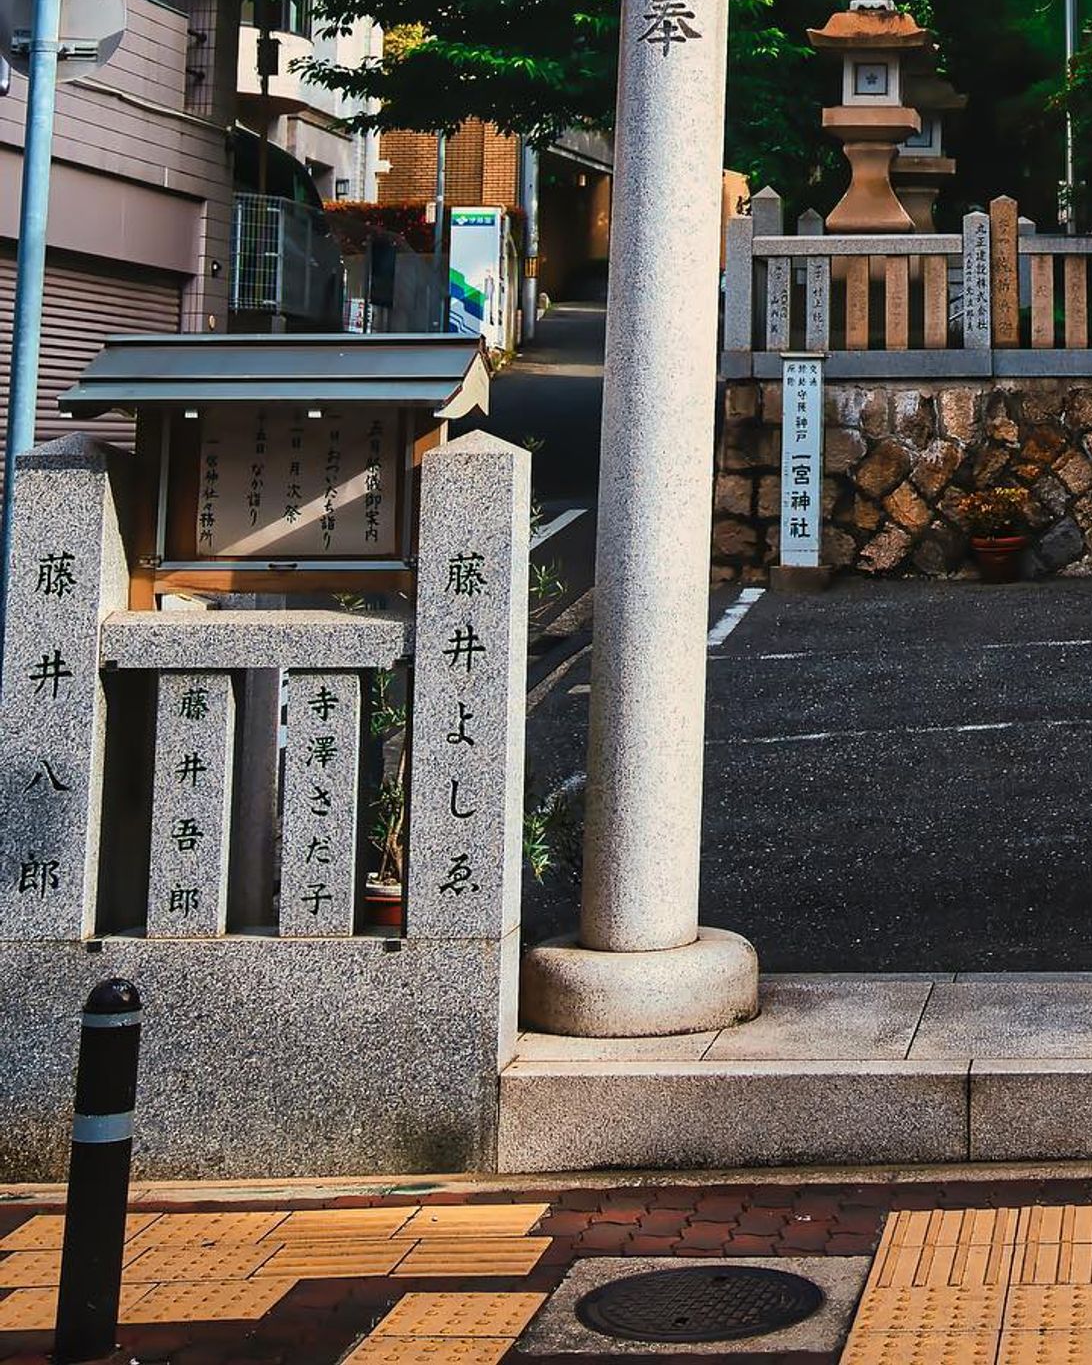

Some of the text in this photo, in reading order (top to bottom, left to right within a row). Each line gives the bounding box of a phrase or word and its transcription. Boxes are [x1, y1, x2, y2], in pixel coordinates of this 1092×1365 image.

[789, 453, 812, 539] 一宮神社
[17, 551, 78, 901] 藤井八郎
[168, 686, 211, 918] 藤井吾郎
[300, 685, 340, 918] 寺澤さだ子
[438, 551, 489, 897] 藤井よしゑ
